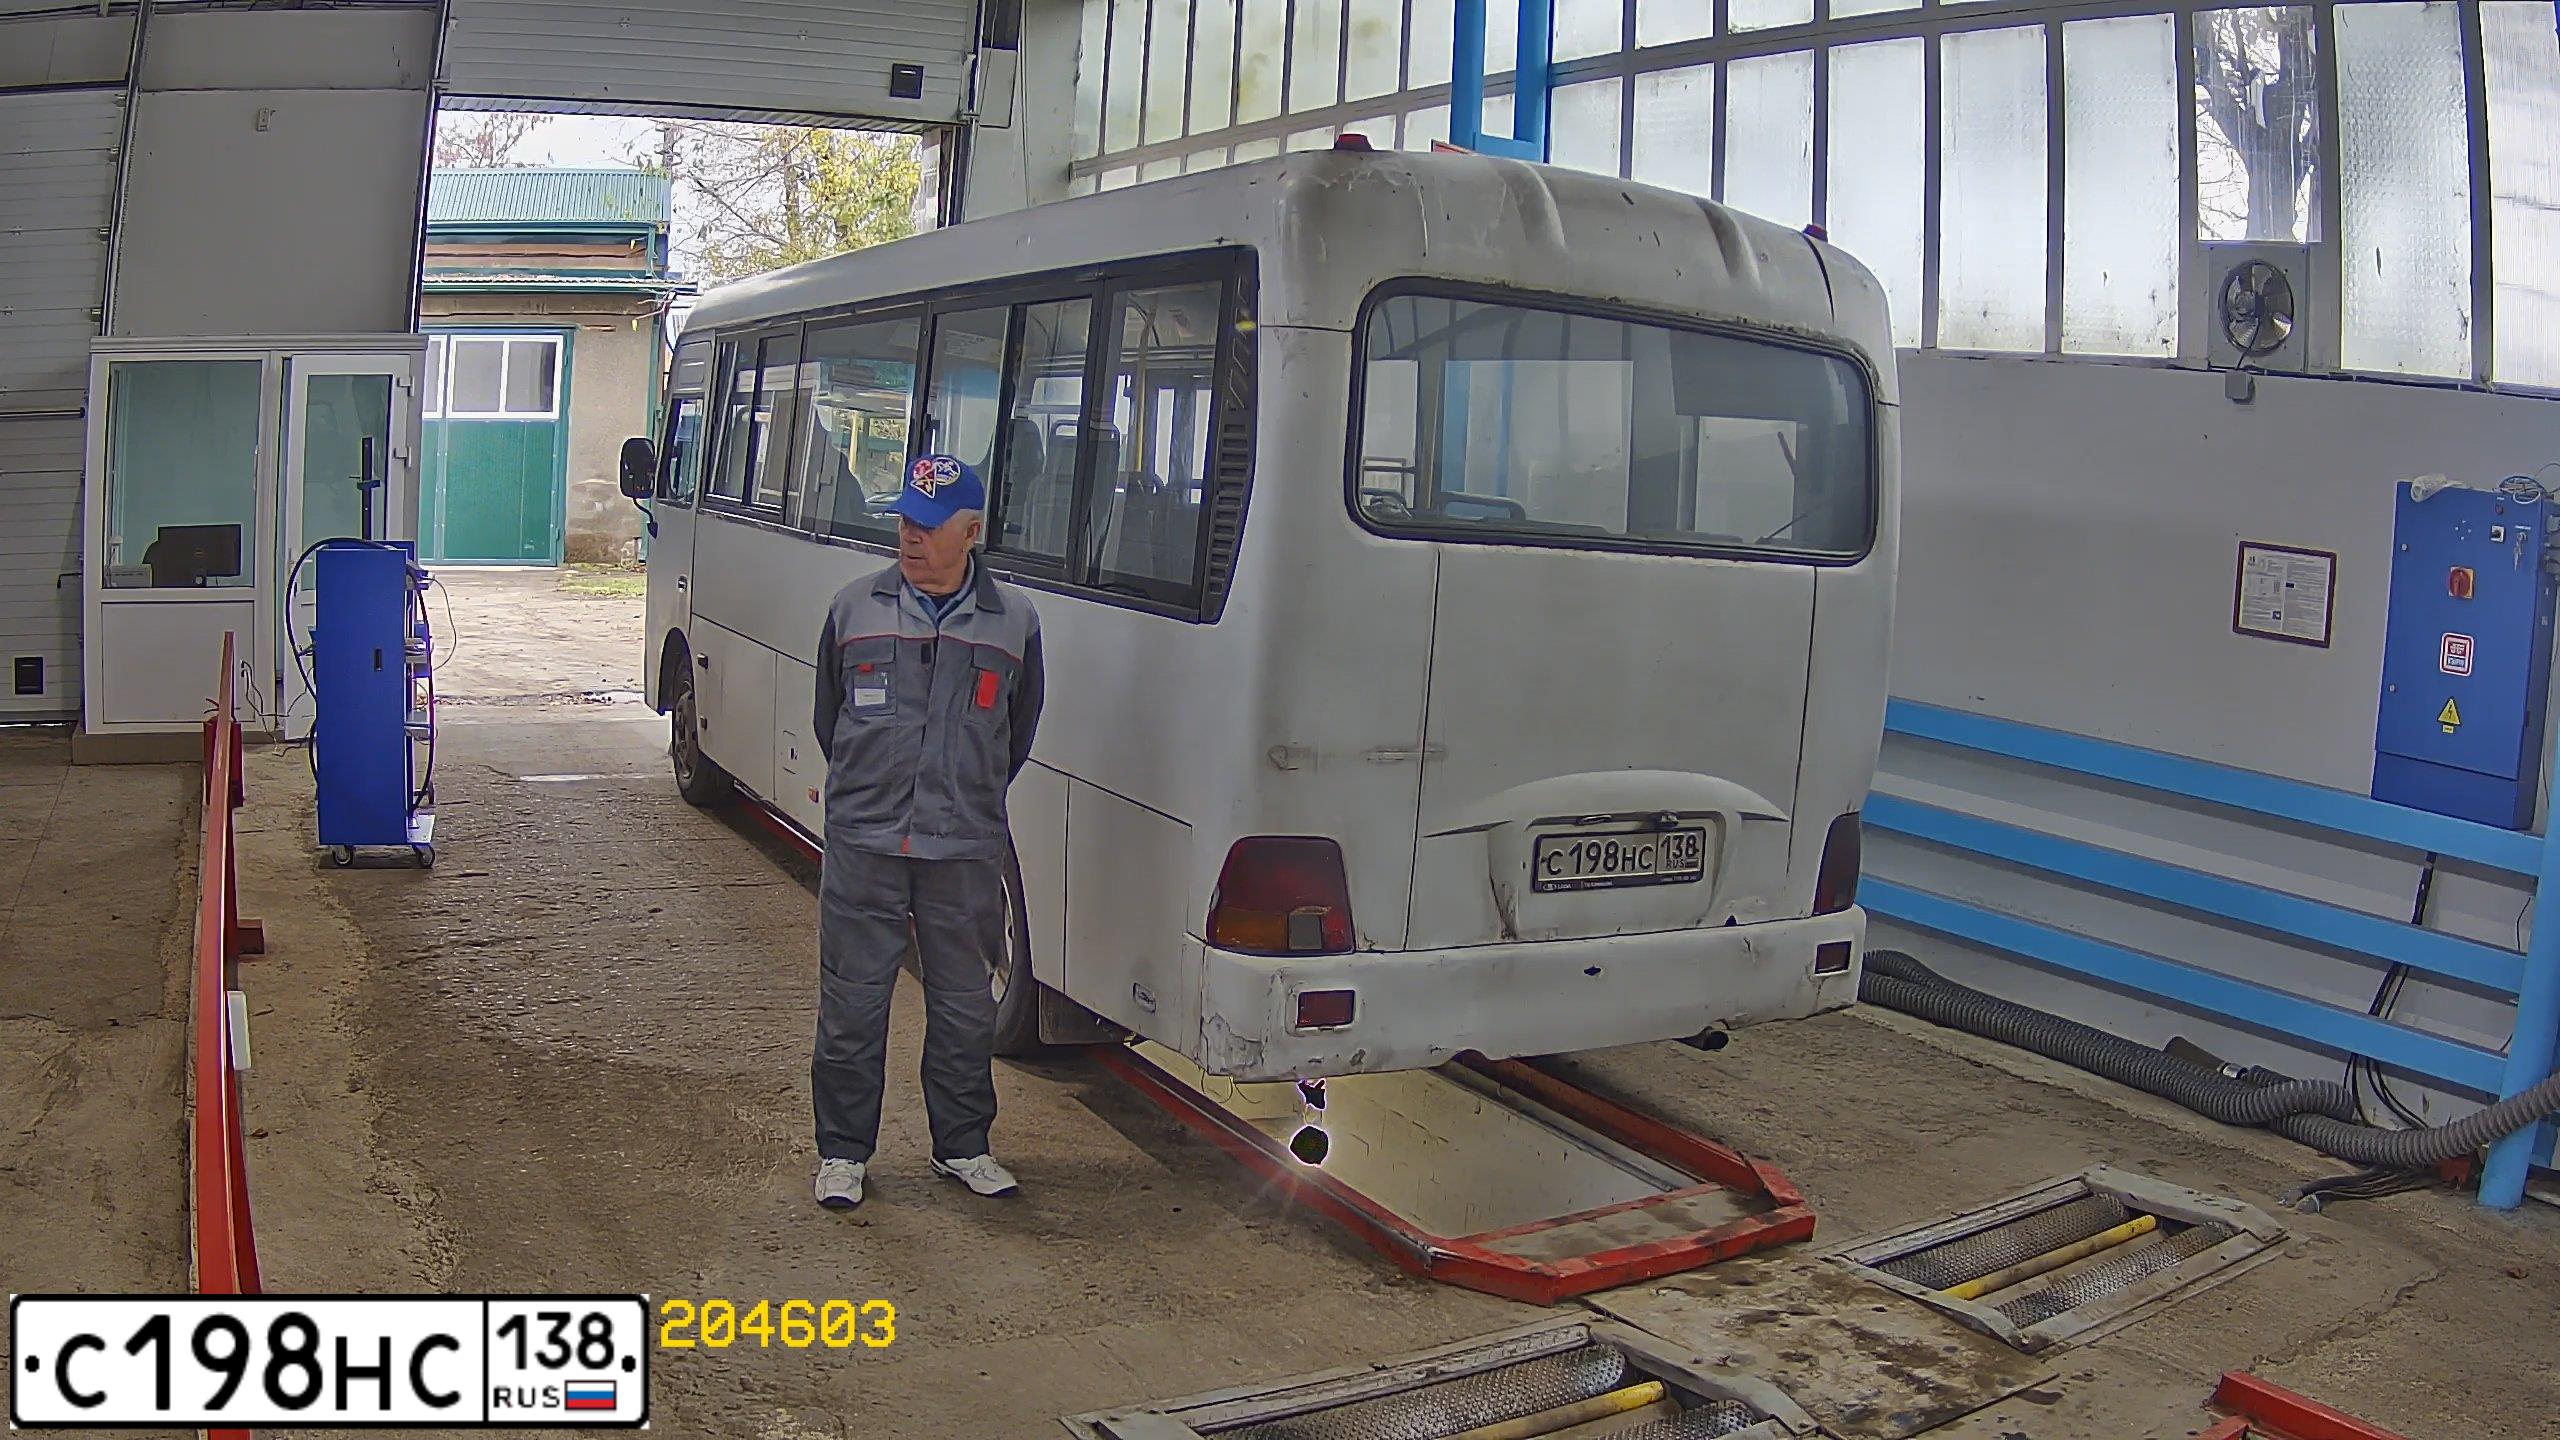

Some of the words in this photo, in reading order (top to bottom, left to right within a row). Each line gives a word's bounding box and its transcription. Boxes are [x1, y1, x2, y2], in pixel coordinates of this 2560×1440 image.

[1547, 839, 1654, 876] С198НС
[1660, 834, 1697, 860] 138
[1665, 858, 1685, 869] RUS
